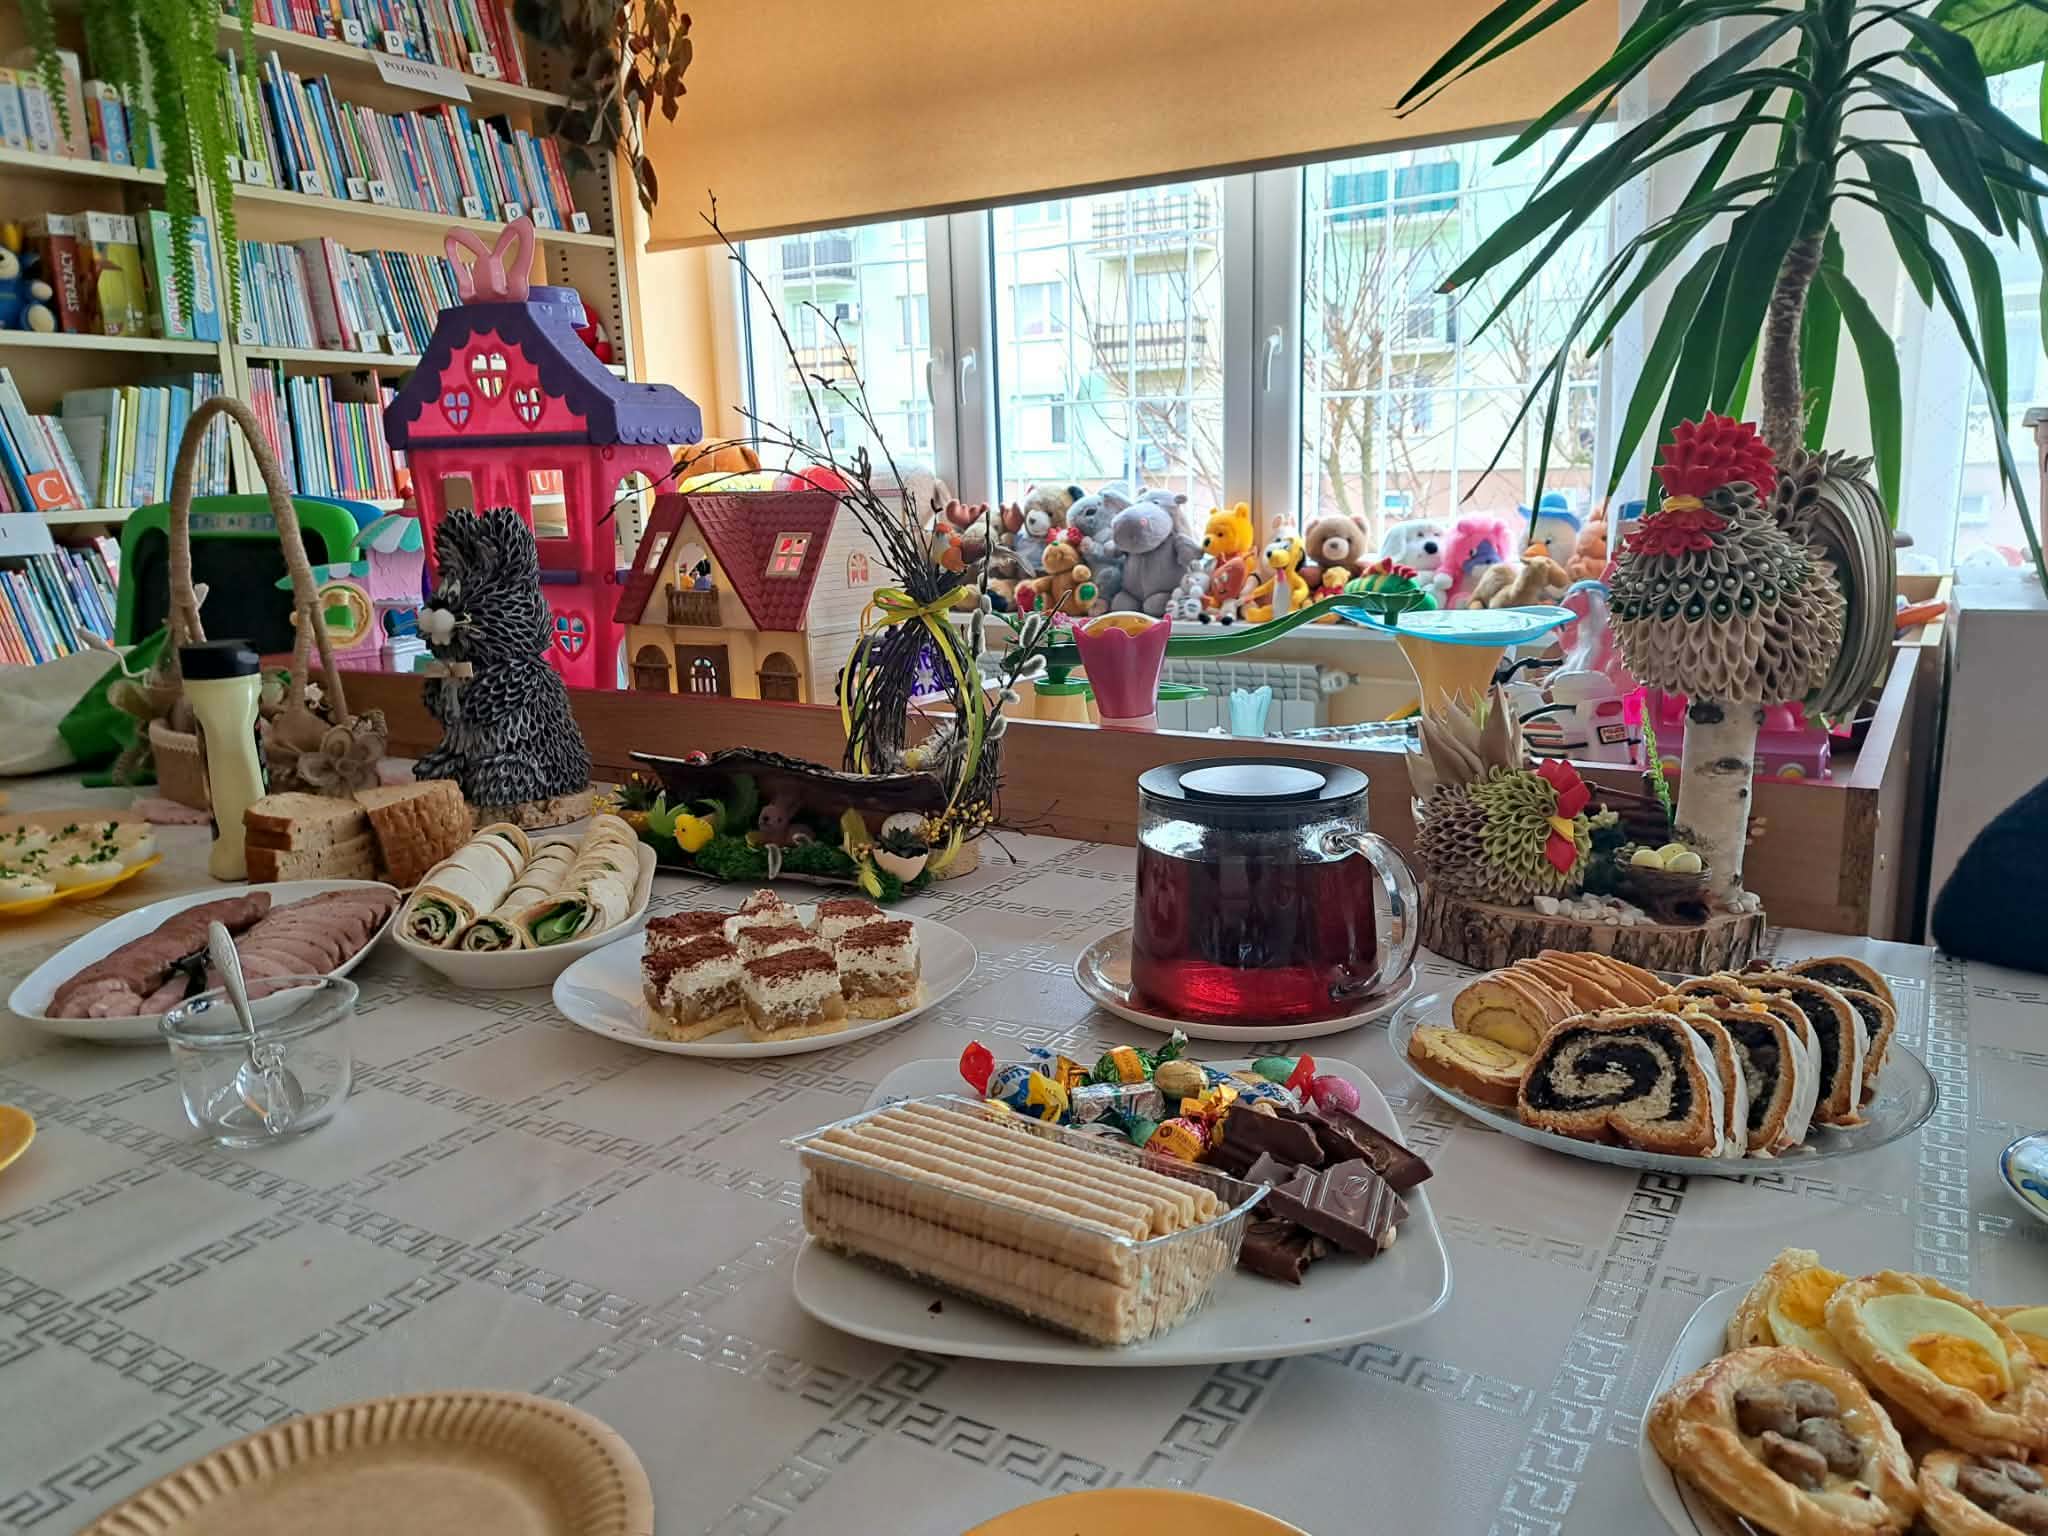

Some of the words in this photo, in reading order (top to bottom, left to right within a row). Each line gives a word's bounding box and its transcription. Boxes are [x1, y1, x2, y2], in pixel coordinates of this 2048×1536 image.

[349, 24, 358, 36] C
[391, 35, 399, 47] D
[250, 166, 258, 178] J
[306, 176, 317, 188] K
[355, 183, 362, 194] L
[374, 187, 385, 198] M
[468, 200, 477, 211] N
[510, 207, 518, 218] O
[243, 328, 253, 340] S
[393, 336, 406, 348] W
[37, 477, 64, 503] C
